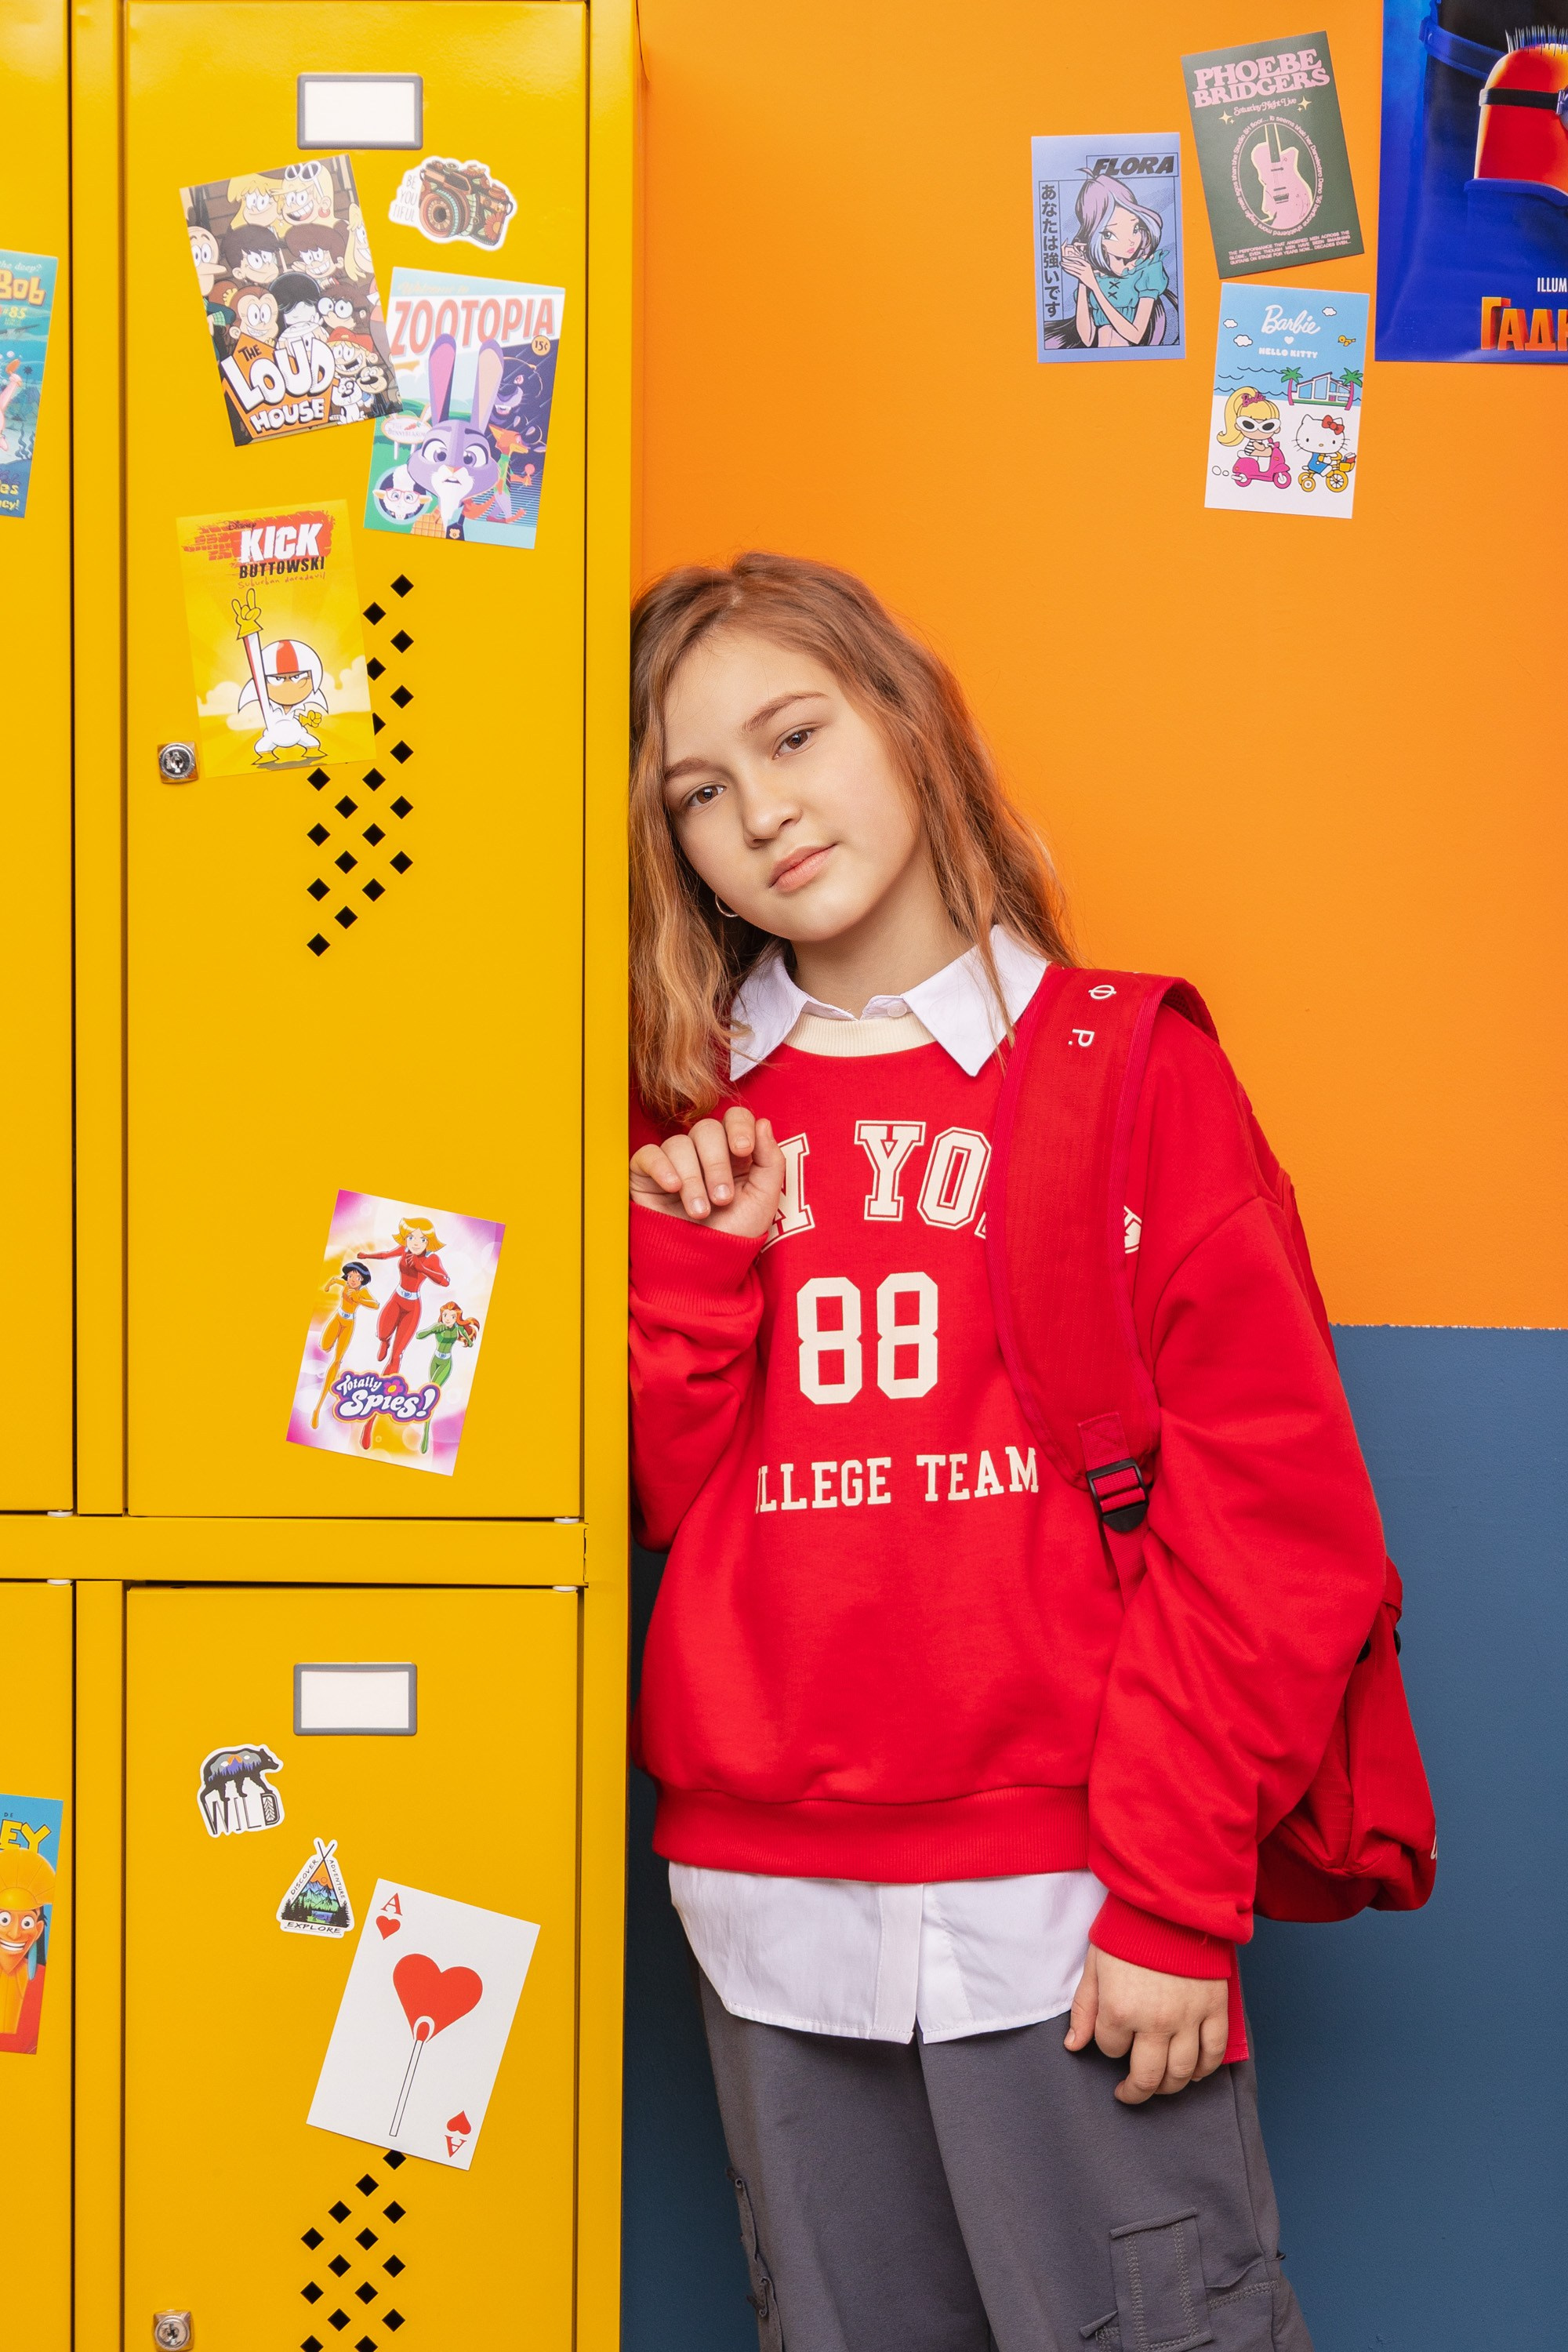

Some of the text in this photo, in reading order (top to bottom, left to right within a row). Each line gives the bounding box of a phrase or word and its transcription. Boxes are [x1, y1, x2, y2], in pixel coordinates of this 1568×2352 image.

[1194, 49, 1322, 90] PHOEBE
[1192, 68, 1330, 108] BRIDGERS
[1233, 97, 1297, 116] Saturday Night Live
[1092, 155, 1174, 176] FLORA
[406, 175, 416, 189] BE
[401, 189, 417, 205] YOU
[393, 204, 415, 222] TIFUL
[1239, 244, 1273, 253] PERFORMANCE
[1327, 234, 1351, 243] SMASHING
[1041, 184, 1060, 318] あなたは強いです
[1537, 277, 1568, 292] ILLUM
[391, 298, 554, 357] ZOOTOPIA
[1261, 304, 1321, 335] Barbie
[238, 344, 262, 361] THE
[1258, 347, 1318, 359] HELLO KITTY
[218, 337, 336, 414] LOUD
[249, 398, 325, 434] HOUSE
[241, 523, 323, 564] KICK
[239, 556, 325, 579] BUTTOWSKI
[796, 1271, 938, 1405] 88
[336, 1374, 383, 1396] Totally
[339, 1388, 436, 1418] Spies!
[916, 1446, 1040, 1501] TEAM
[201, 1793, 281, 1835] WILD
[291, 1860, 318, 1896] DISCOVER
[329, 1859, 346, 1899] ADVENTURE
[381, 1893, 403, 1916] A
[287, 1922, 343, 1934] EXPLORE
[444, 2135, 467, 2158] A
